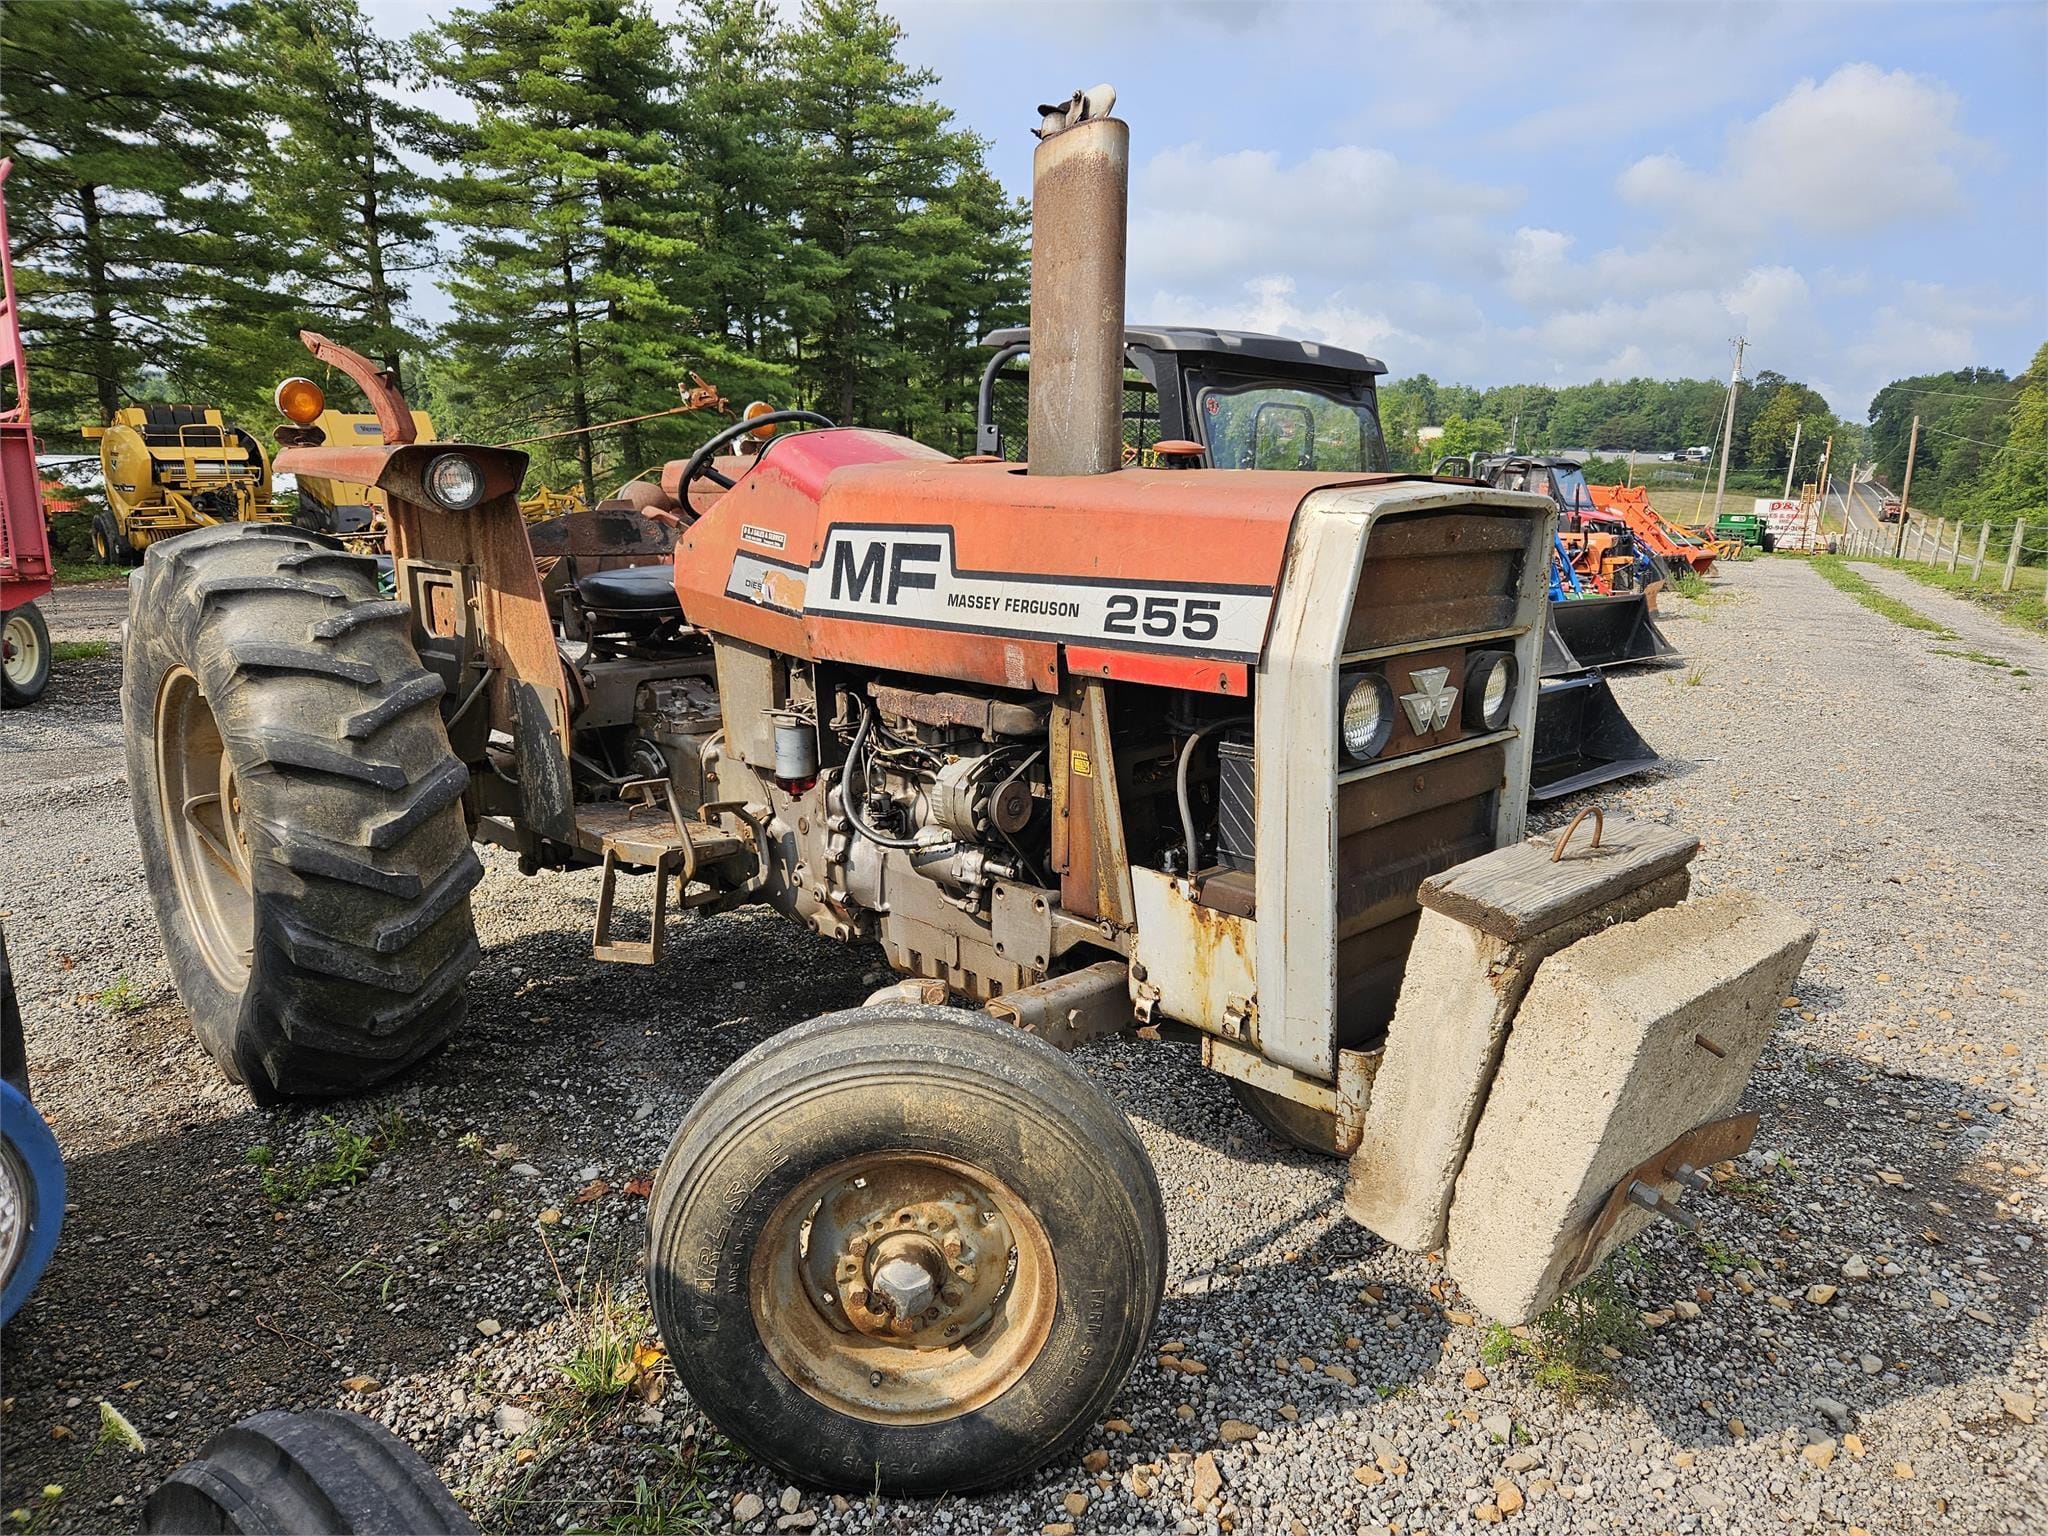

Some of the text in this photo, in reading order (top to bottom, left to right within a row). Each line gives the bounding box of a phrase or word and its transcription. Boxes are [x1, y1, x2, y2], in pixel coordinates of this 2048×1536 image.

[1771, 502, 1781, 510] D
[1783, 501, 1792, 509] &
[768, 533, 784, 542] SERVICE
[830, 541, 941, 606] MF
[947, 592, 1080, 619] MASSEY FERGUSON
[1103, 593, 1221, 642] 255
[691, 1143, 790, 1333] CARLISLE
[741, 1216, 756, 1237] THE
[733, 1242, 745, 1256] IN
[727, 1262, 741, 1296] MADE
[1086, 1288, 1106, 1337] FARM
